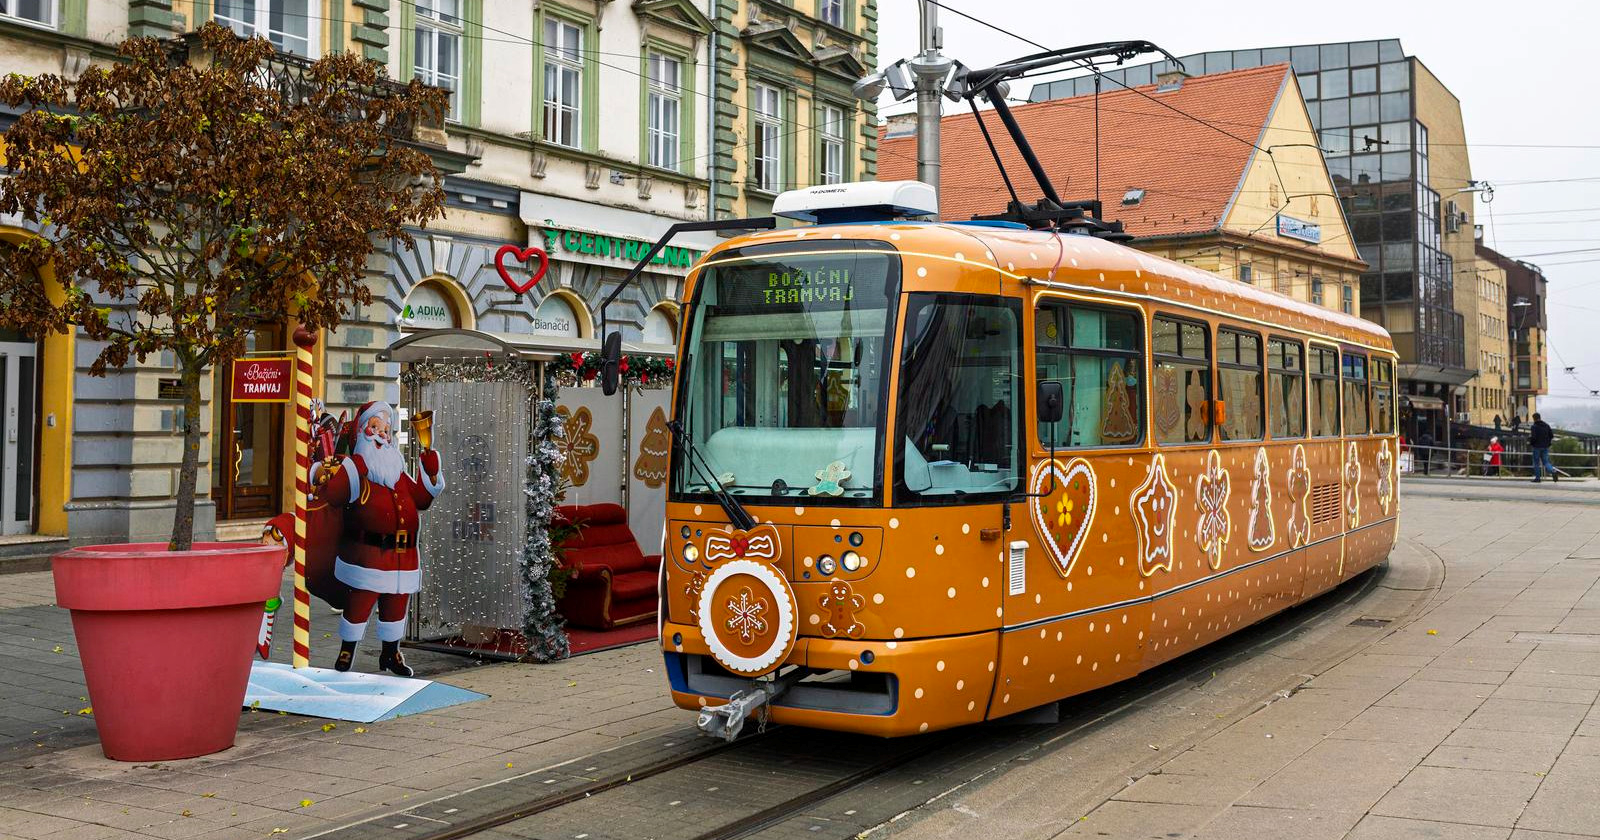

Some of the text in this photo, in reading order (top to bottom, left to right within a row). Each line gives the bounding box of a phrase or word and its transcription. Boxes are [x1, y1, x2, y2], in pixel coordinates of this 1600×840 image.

[564, 230, 691, 268] CENTRALNA
[768, 266, 849, 287] BOŽIĆNI
[762, 286, 854, 304] TRAMVAJ
[416, 305, 446, 317] ADIVA
[534, 318, 570, 331] Bianacid
[243, 383, 281, 393] TRAMVAJ
